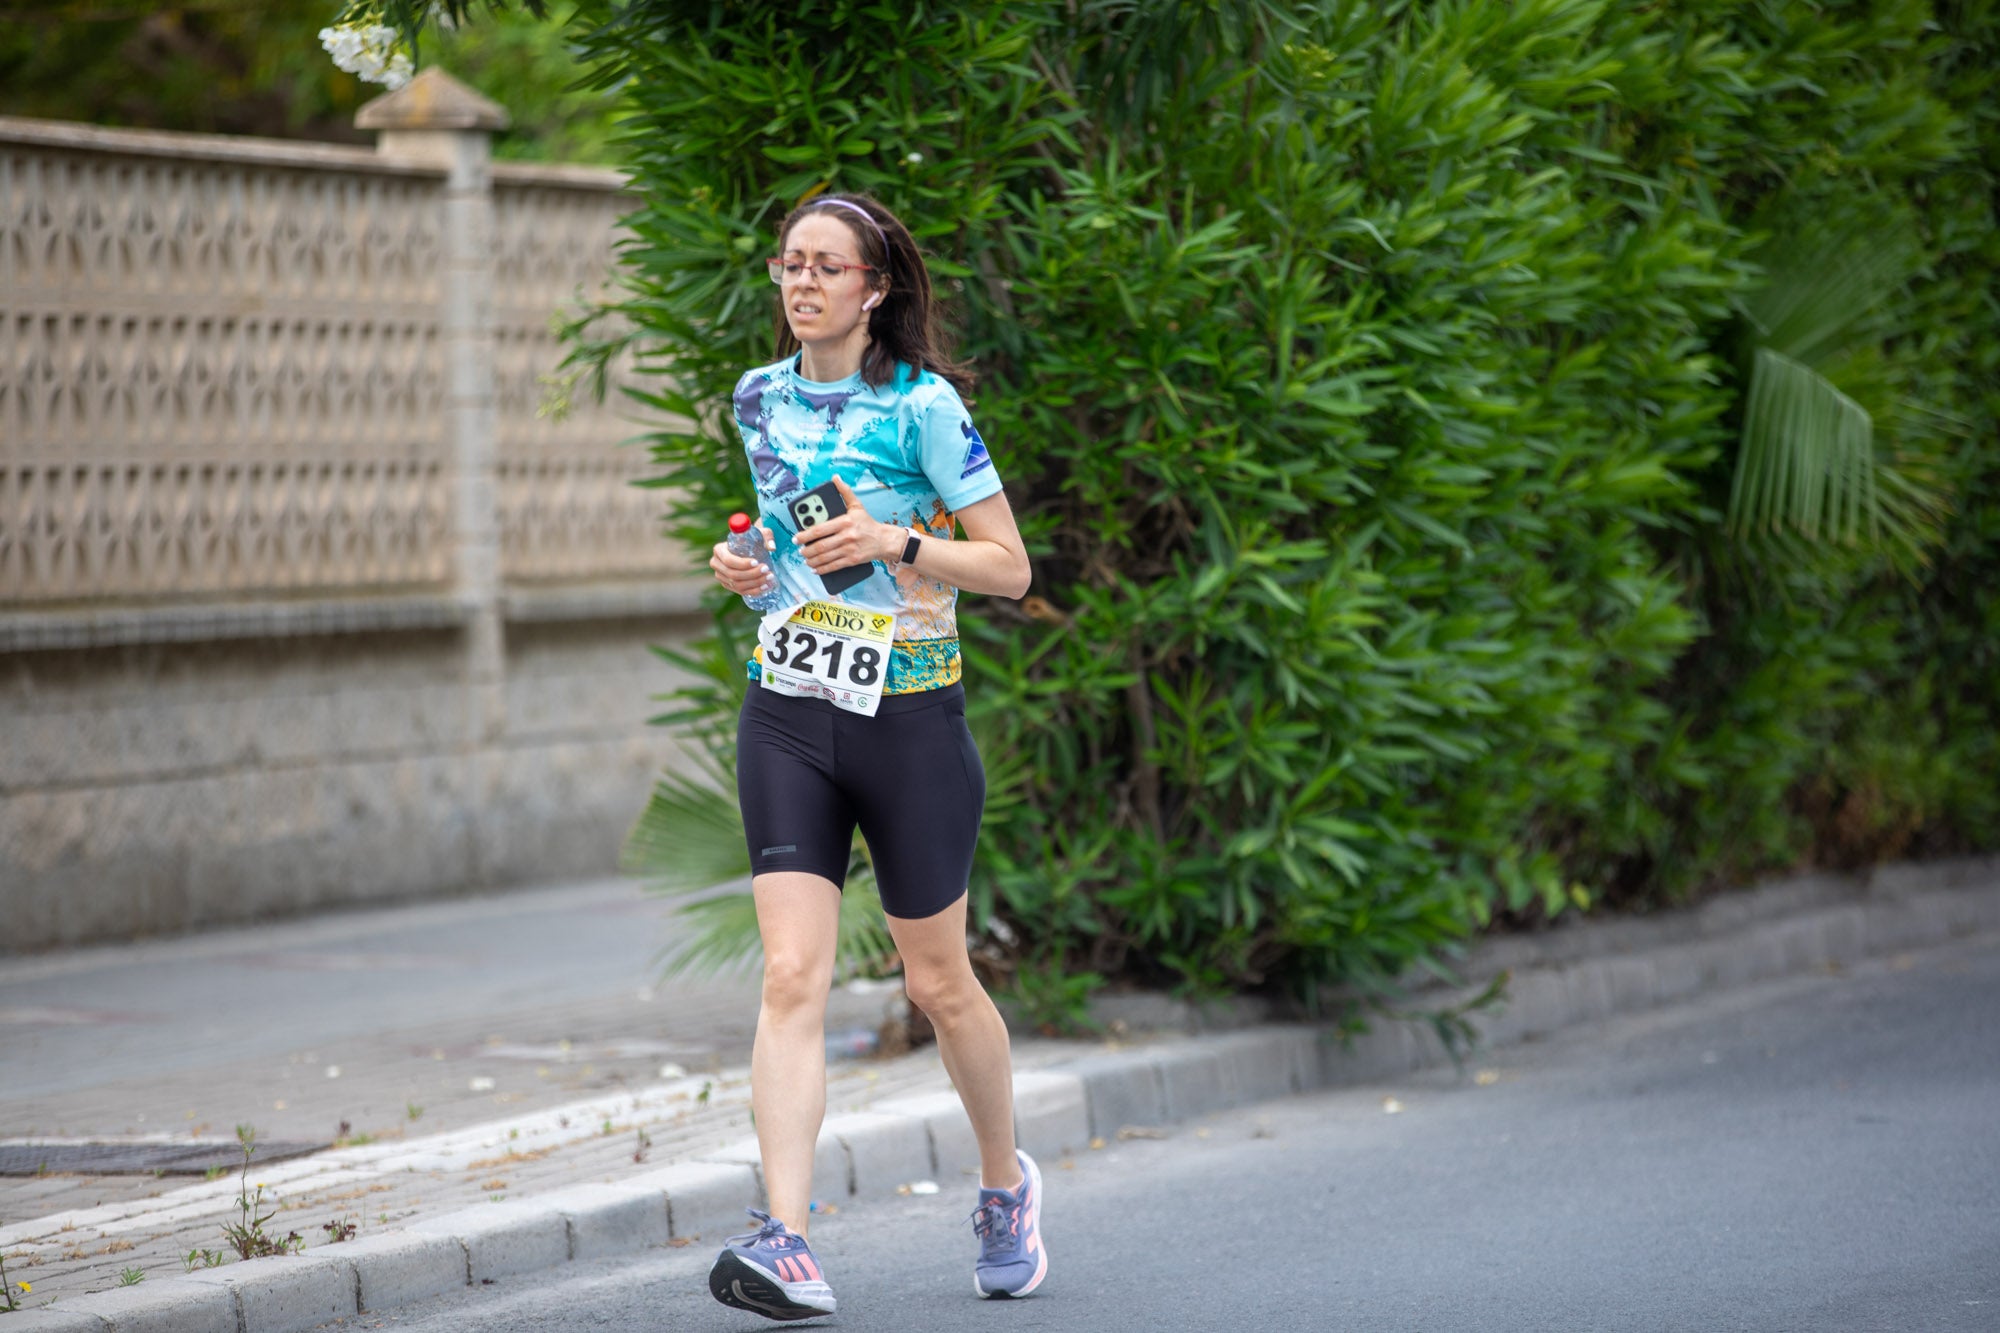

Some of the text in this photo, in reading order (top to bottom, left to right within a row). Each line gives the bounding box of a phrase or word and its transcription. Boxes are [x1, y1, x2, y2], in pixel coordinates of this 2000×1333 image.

[800, 606, 864, 632] FONDO
[828, 604, 860, 618] PREMIO
[766, 626, 881, 687] 3218
